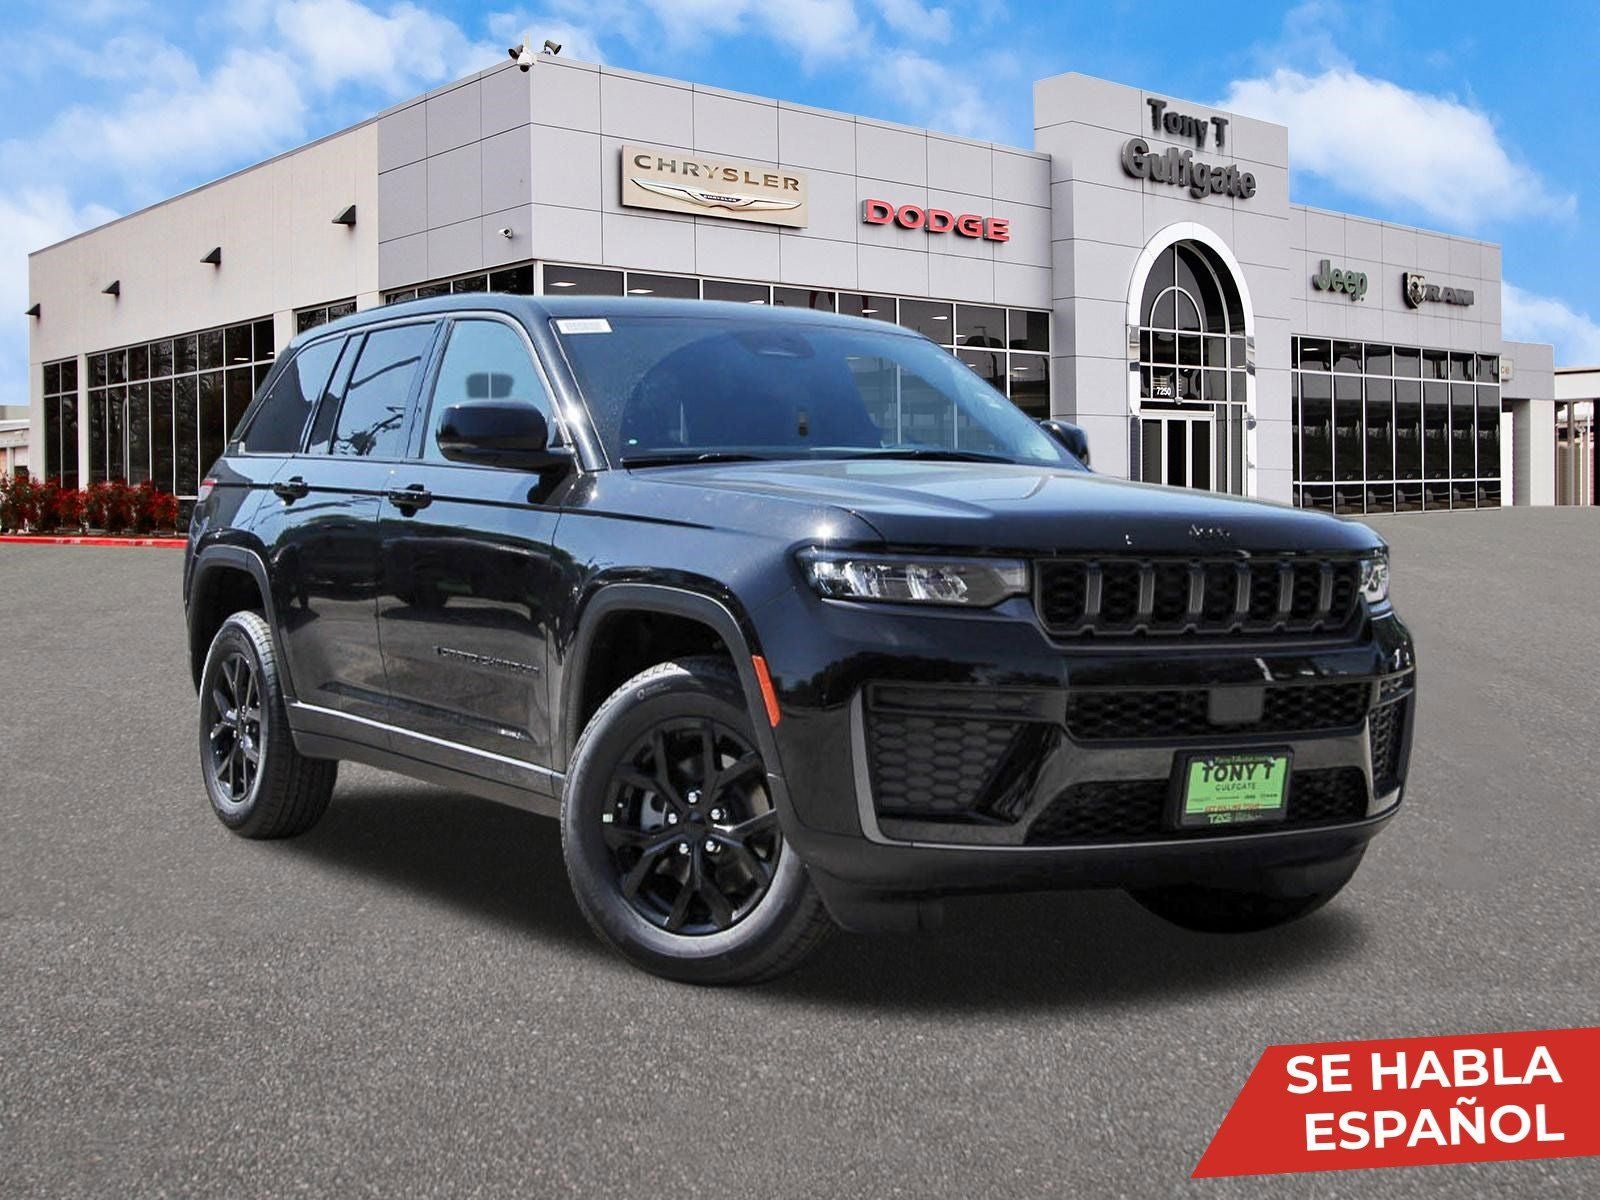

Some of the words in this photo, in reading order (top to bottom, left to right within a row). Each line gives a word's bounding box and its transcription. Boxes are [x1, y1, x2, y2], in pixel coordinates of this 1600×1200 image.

[1146, 98, 1208, 148] Tony
[1210, 116, 1229, 147] T
[633, 154, 801, 192] CHRYSLER
[1121, 138, 1256, 199] Gulfgate
[862, 198, 1010, 242] DODGE
[1312, 259, 1368, 302] Jeep
[1425, 284, 1475, 307] RAM
[1156, 386, 1172, 396] 7250
[1202, 762, 1258, 783] TONY
[1264, 762, 1275, 780] T
